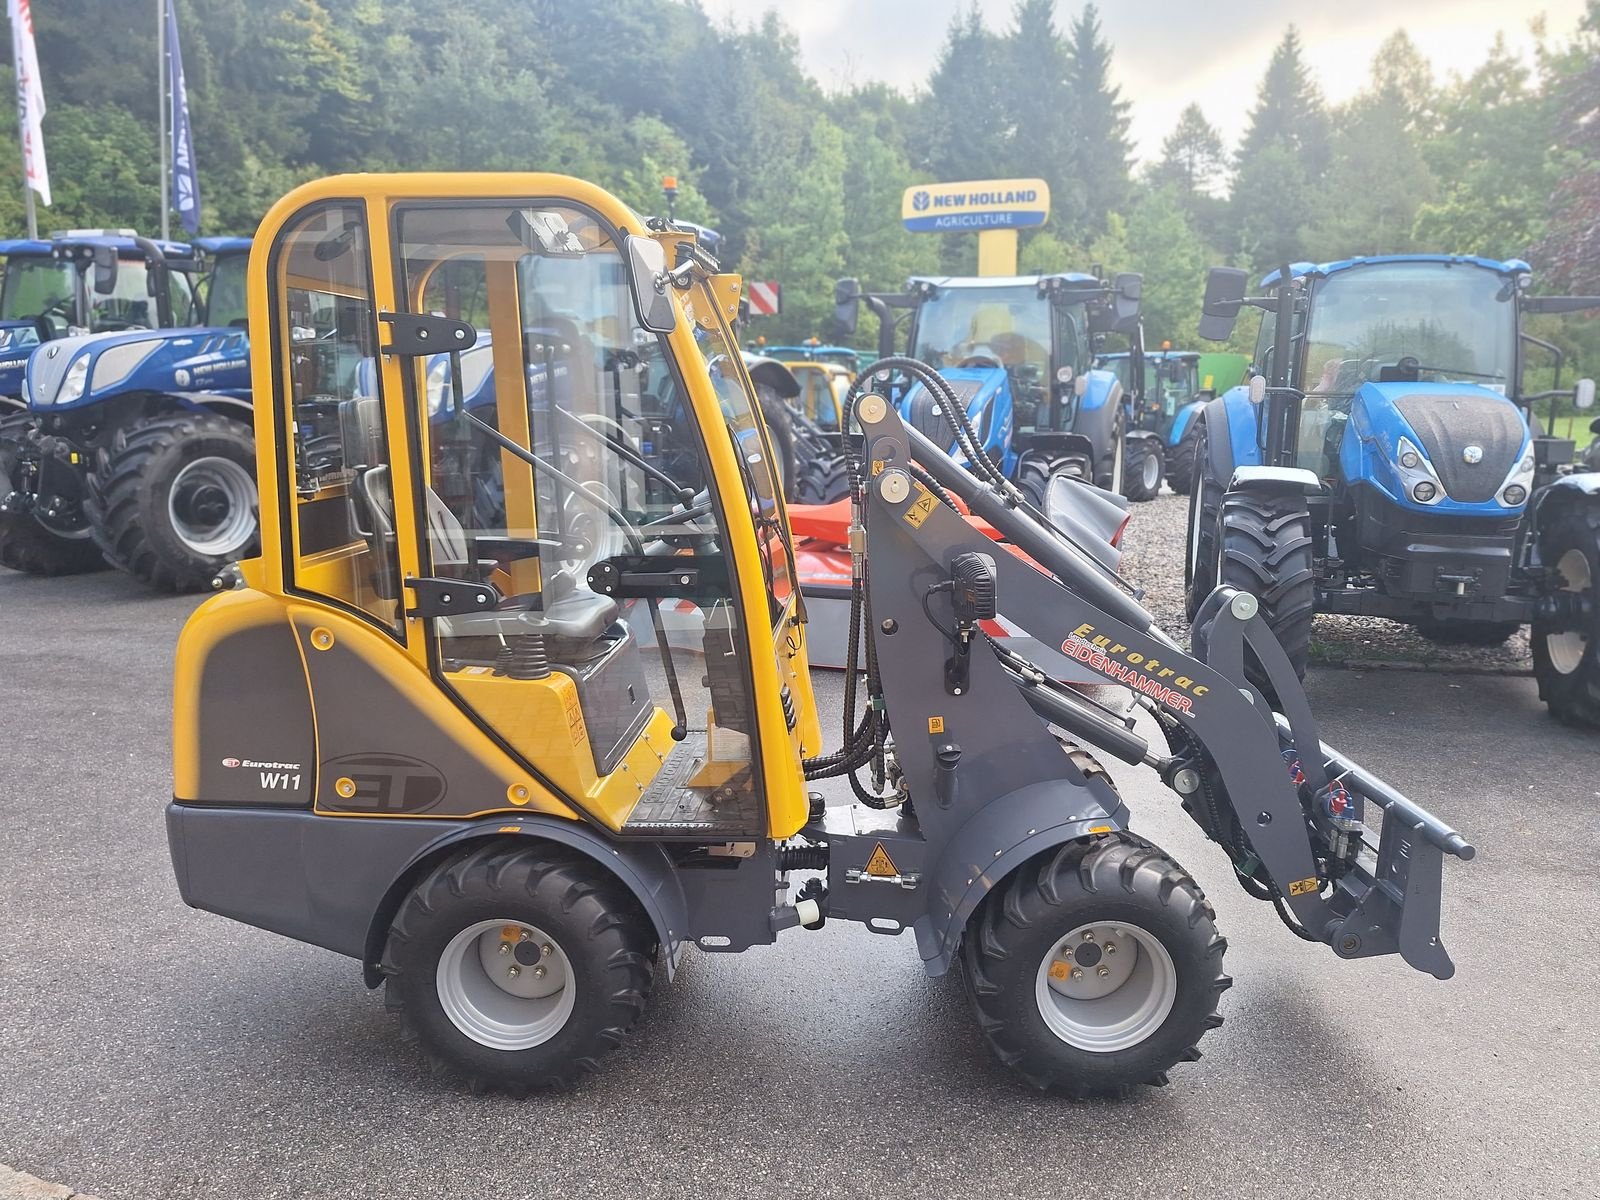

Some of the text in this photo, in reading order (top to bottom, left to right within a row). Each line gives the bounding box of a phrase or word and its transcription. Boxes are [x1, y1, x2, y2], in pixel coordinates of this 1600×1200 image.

[934, 190, 1037, 208] NEW HOLLAND
[935, 213, 1012, 227] AGRICULTURE
[1068, 632, 1107, 656] Landtechnik
[1073, 623, 1209, 697] Eurotrac
[1061, 638, 1194, 716] EIDENHAMMER
[242, 760, 300, 770] Eurotrac
[260, 772, 301, 790] W11
